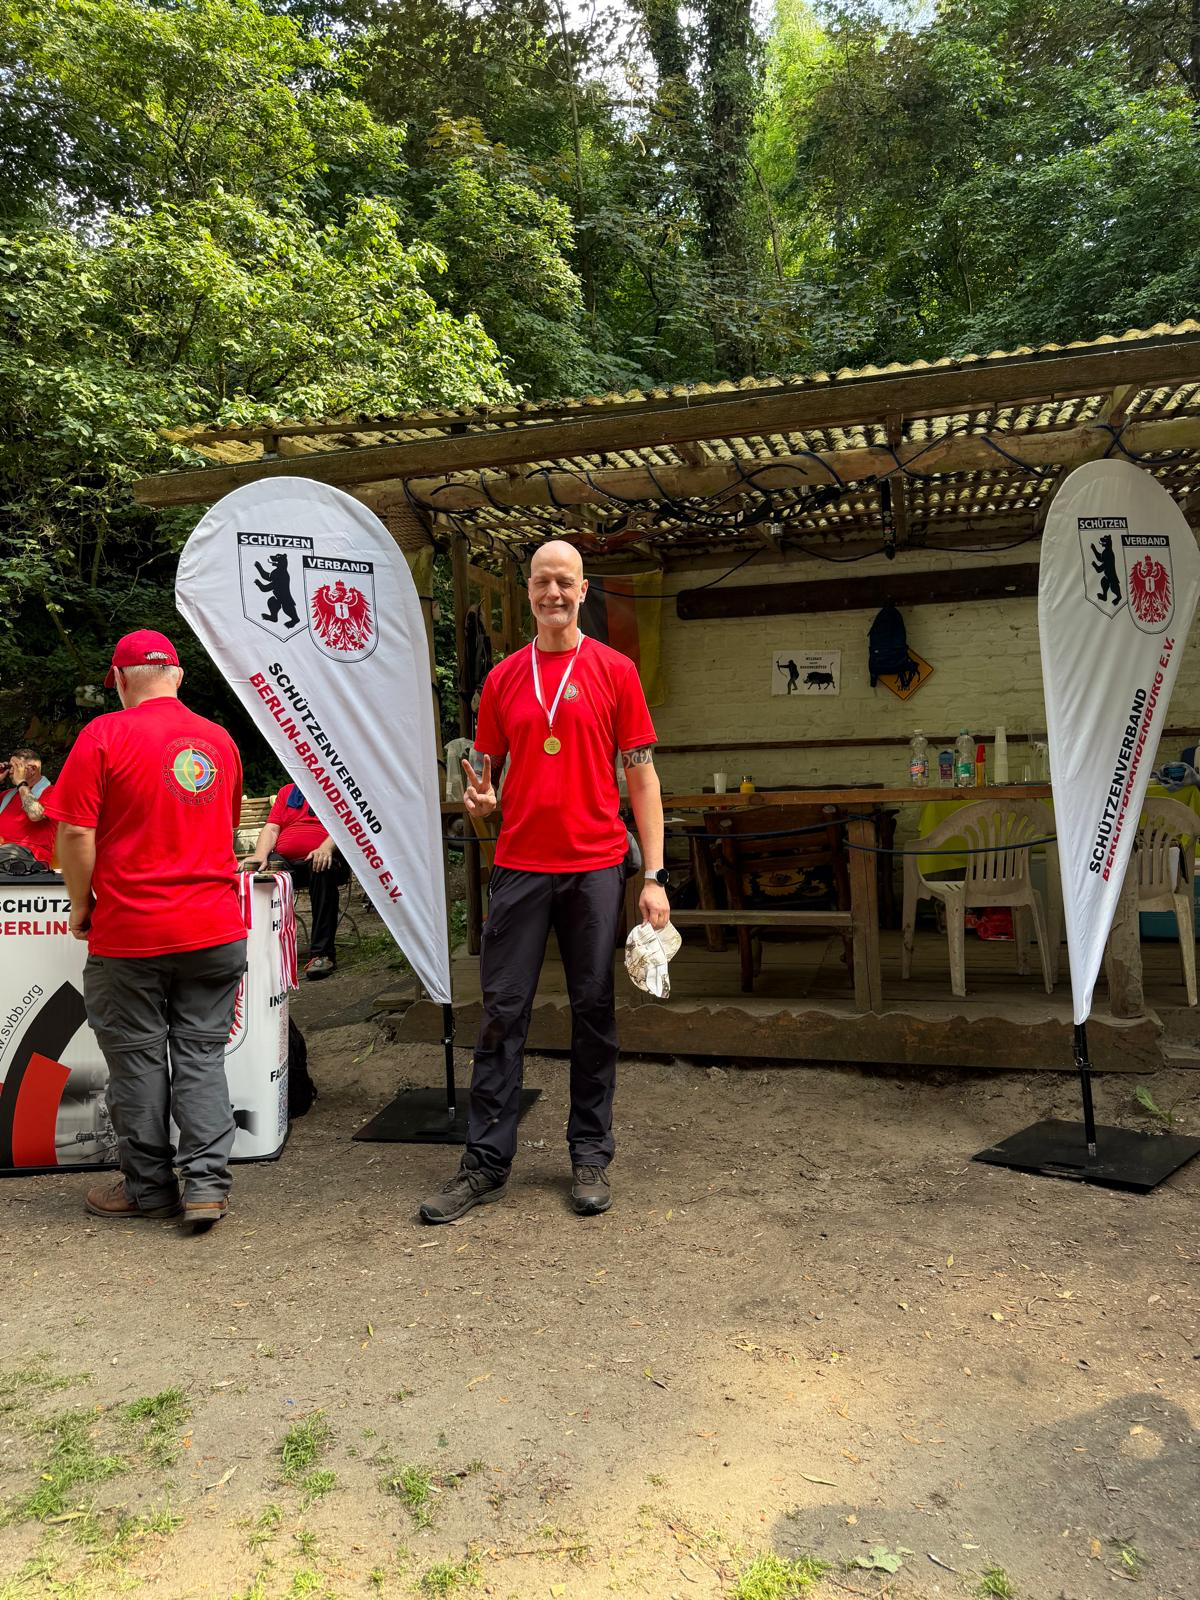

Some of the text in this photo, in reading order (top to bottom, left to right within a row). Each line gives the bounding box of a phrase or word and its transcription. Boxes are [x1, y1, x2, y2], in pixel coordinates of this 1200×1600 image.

[1079, 517, 1126, 528] SCHÜTZEN
[240, 534, 311, 549] SCHÜTZEN
[1125, 537, 1166, 546] VERBAND
[306, 557, 370, 572] VERBAND
[1159, 637, 1175, 668] E.V.
[268, 662, 382, 835] SCHÜTZENVERBAND
[249, 672, 403, 904] BERLIN-BRANDENBURG E.V.
[1089, 688, 1147, 874] SCHÜTZENVERBAND
[0, 896, 72, 913] CHÜTZ
[0, 921, 71, 935] ERLIN
